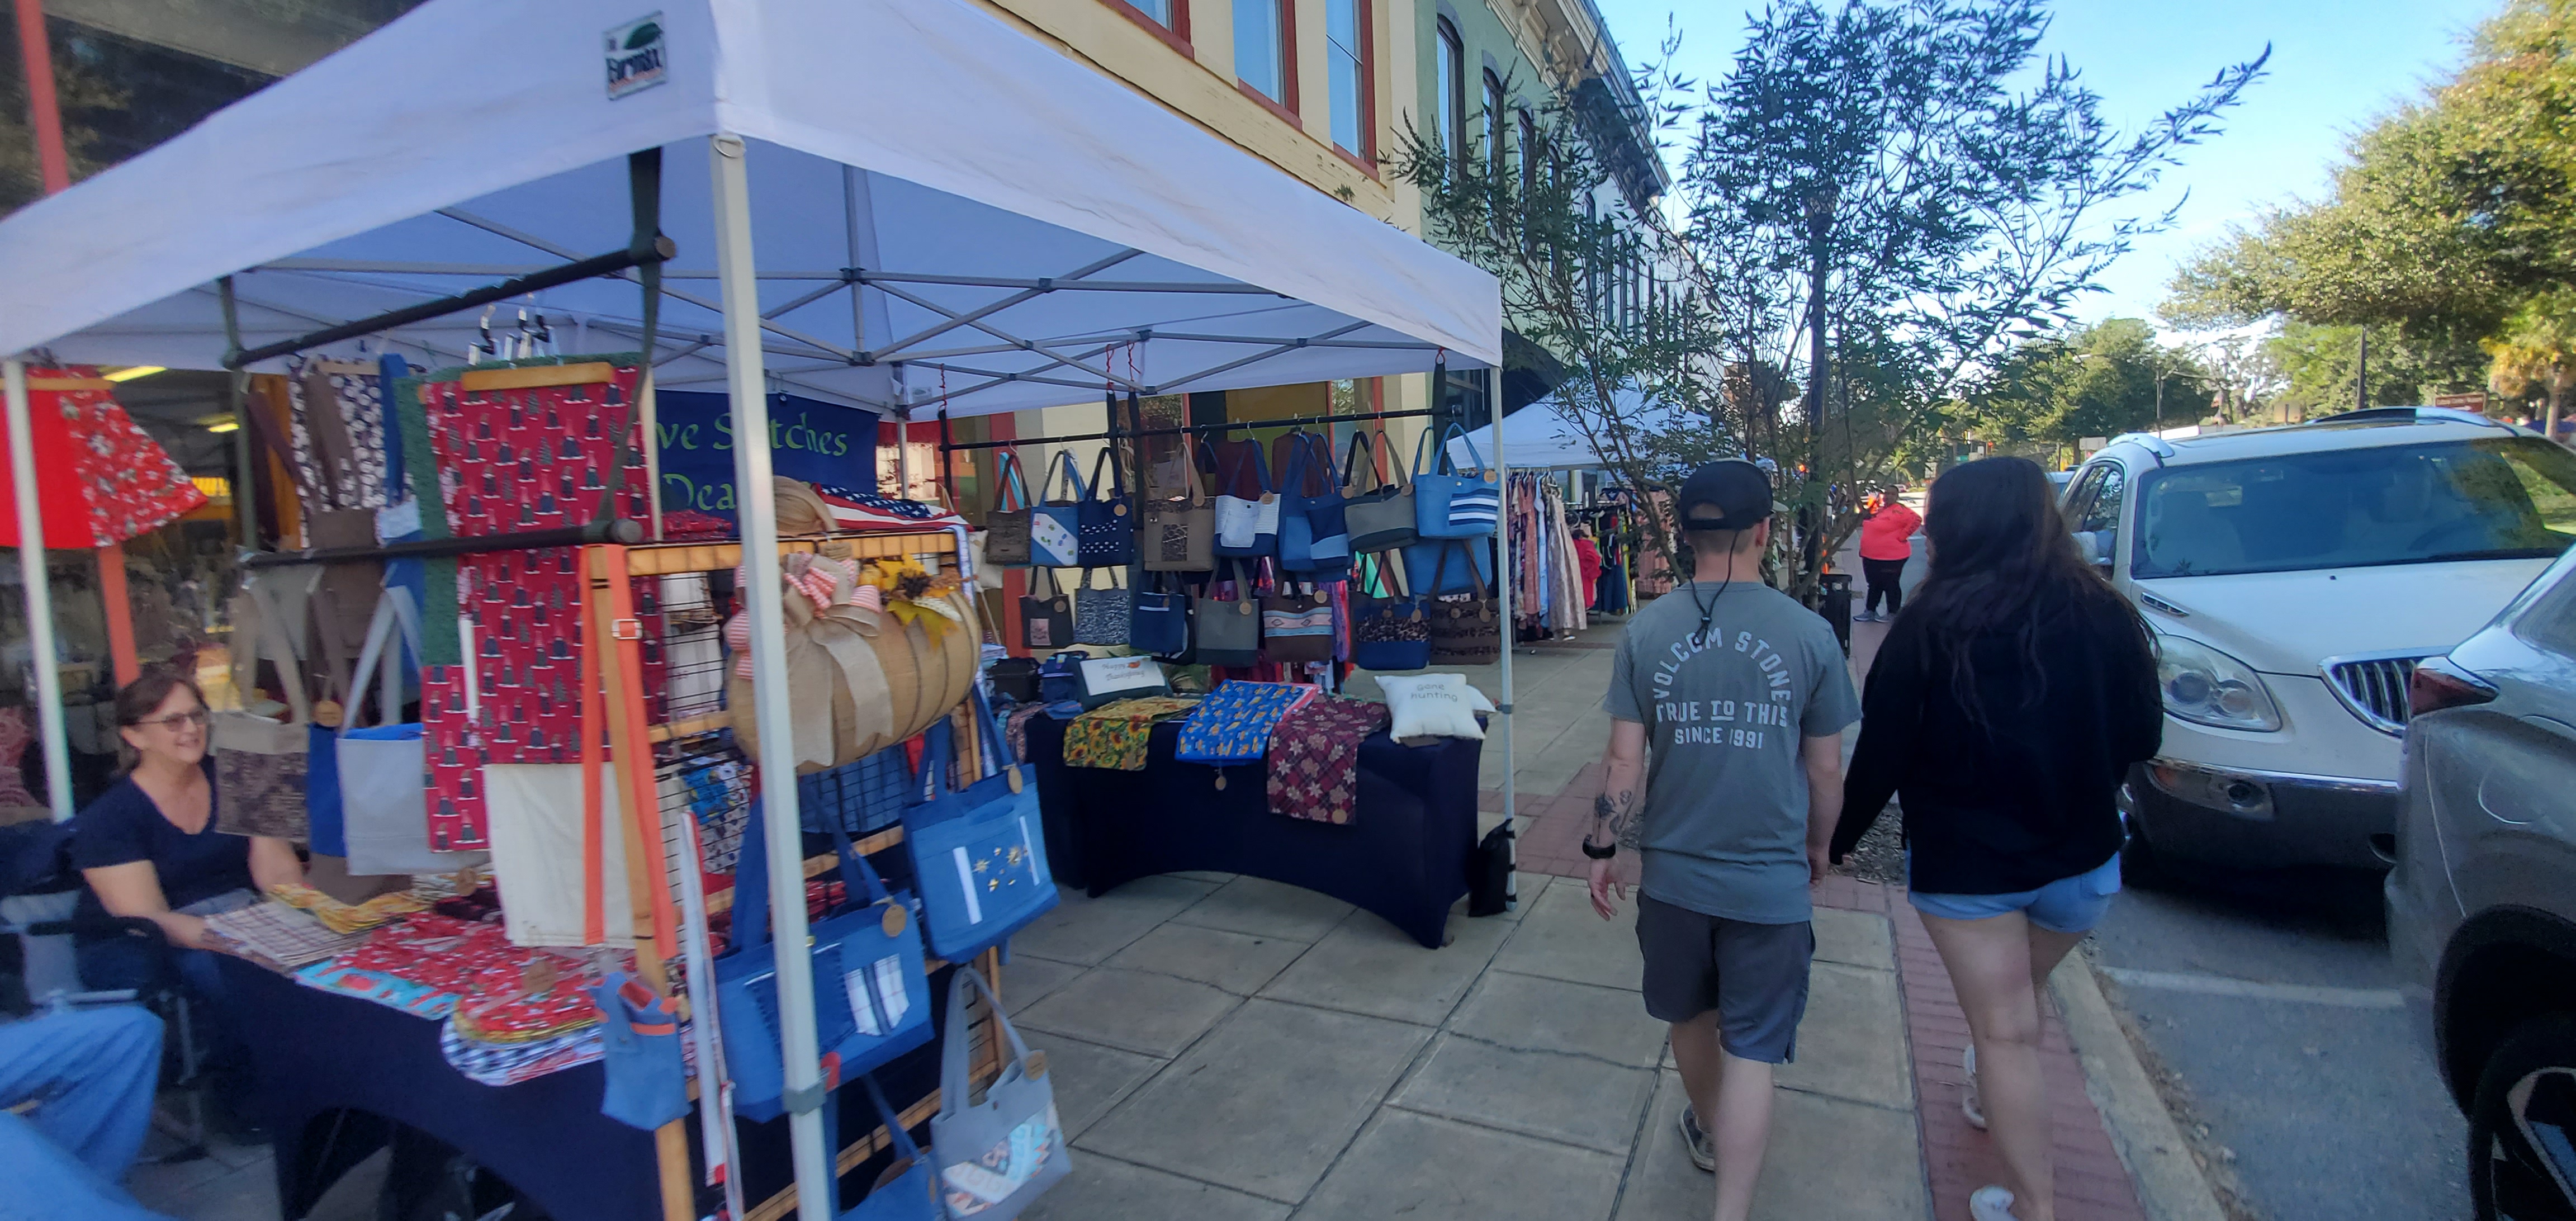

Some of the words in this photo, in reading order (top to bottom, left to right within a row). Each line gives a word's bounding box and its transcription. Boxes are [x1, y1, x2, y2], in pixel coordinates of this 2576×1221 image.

[713, 411, 848, 456] Stches
[1653, 627, 1723, 699] VOLCOM
[1735, 631, 1791, 701] STONE
[1410, 692, 1458, 702] hunting
[1655, 701, 1701, 723] TRUE
[1711, 701, 1735, 720] TO
[1744, 702, 1787, 727] THIS
[1674, 727, 1723, 745] SINCE
[1729, 728, 1764, 749] 1991
